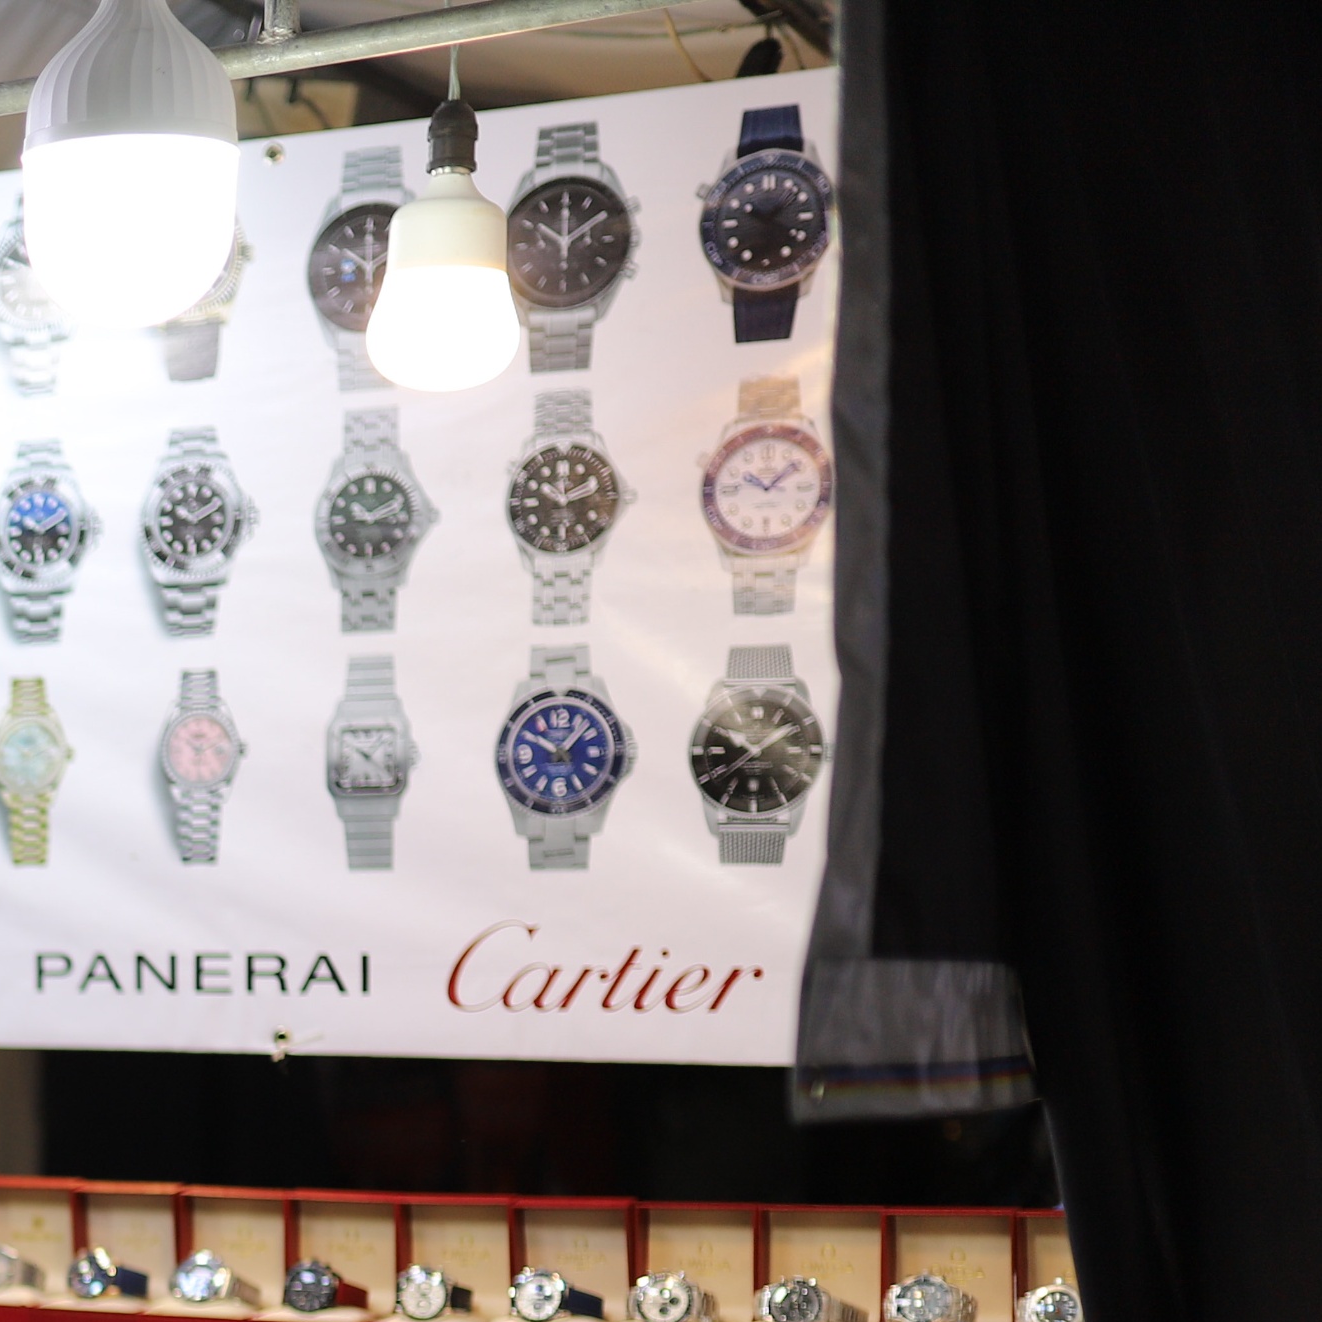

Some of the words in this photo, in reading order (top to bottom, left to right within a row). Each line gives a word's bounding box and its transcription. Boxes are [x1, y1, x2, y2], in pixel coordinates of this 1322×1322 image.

[549, 708, 571, 729] 12
[34, 952, 371, 996] PANERAI
[446, 918, 765, 1014] Cartier
